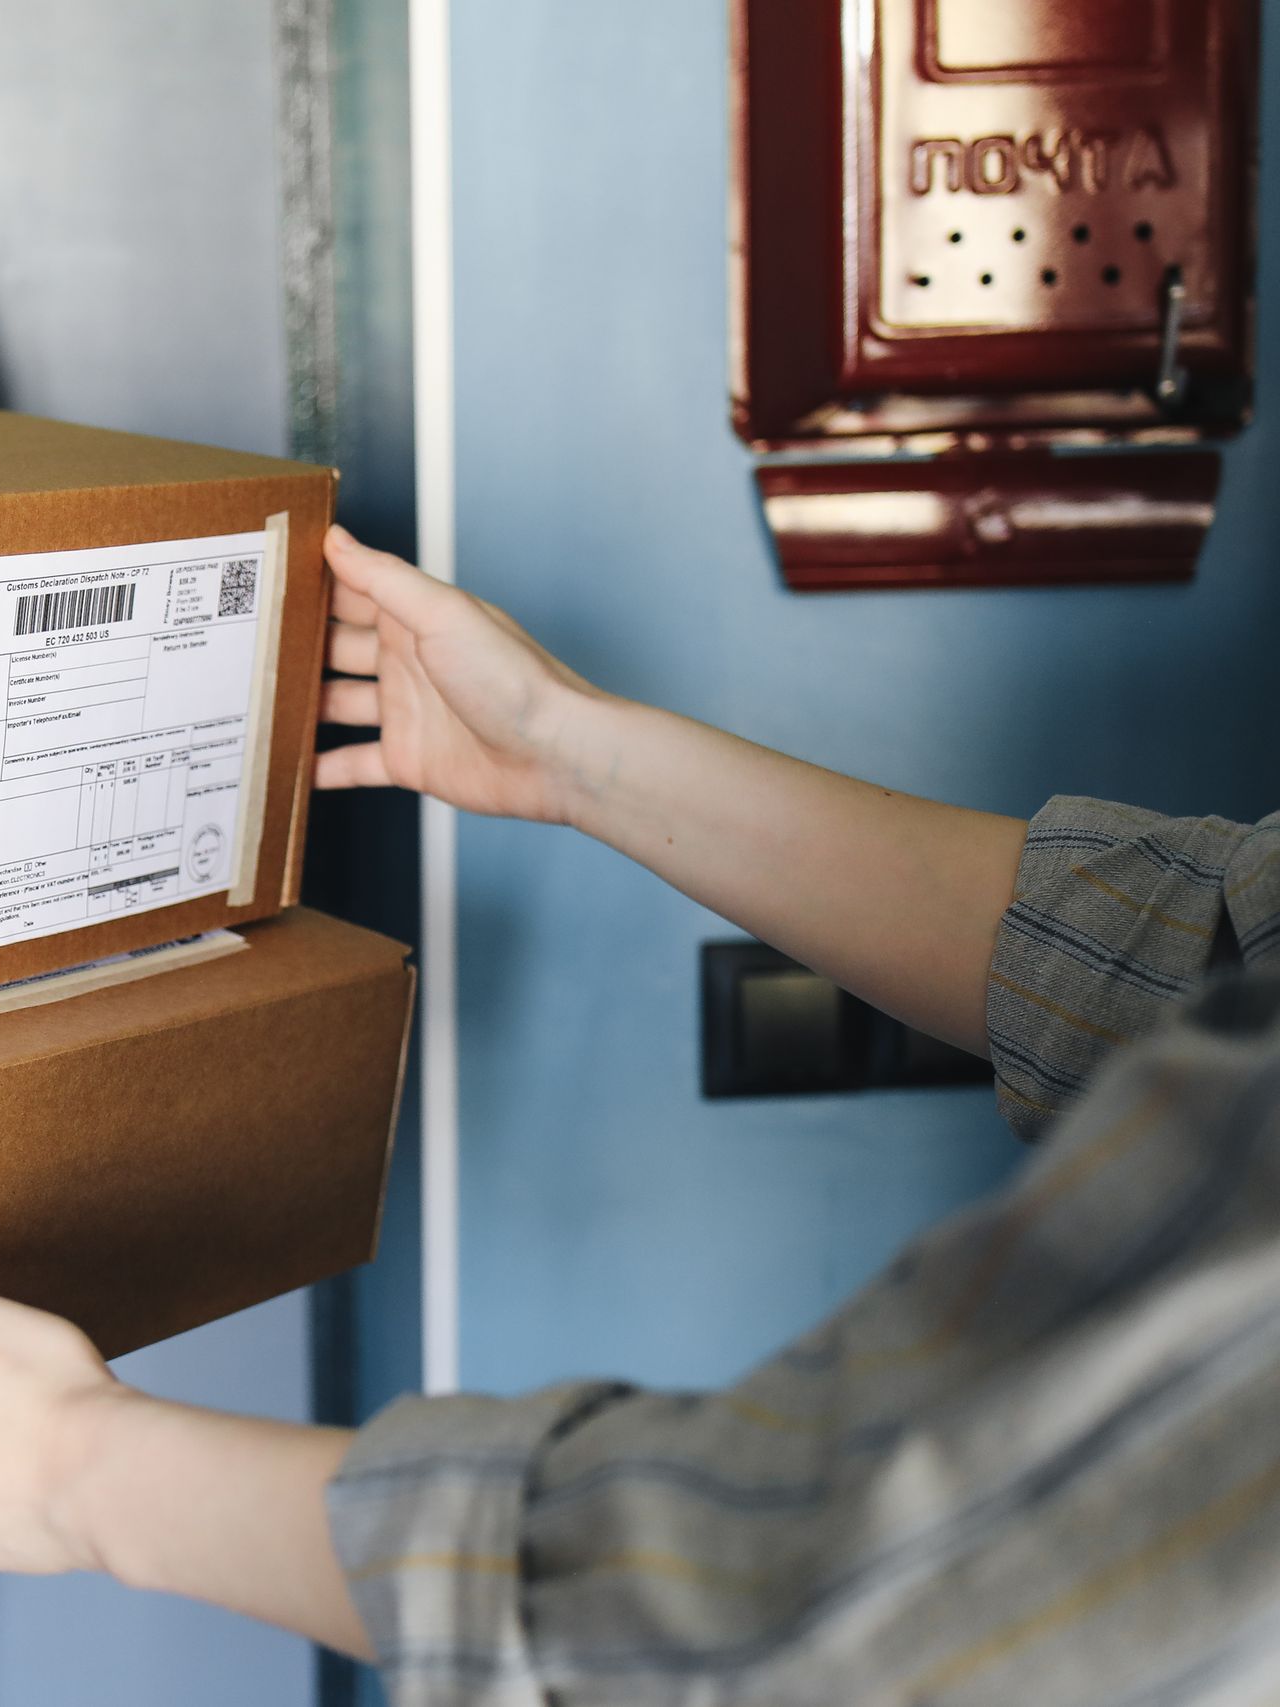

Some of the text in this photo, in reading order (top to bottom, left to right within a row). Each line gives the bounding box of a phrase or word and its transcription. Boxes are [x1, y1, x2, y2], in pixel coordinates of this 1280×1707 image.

[911, 124, 1175, 195] ПОЧТА
[6, 581, 38, 592] Customs
[40, 576, 79, 588] Declaration
[80, 573, 109, 585] Dispatch
[110, 570, 126, 580] Note
[142, 568, 150, 576] 72
[45, 630, 110, 646] EC 720 432 503 US
[11, 651, 58, 664] License Number(s)
[10, 673, 61, 686] Certificate Number(s)
[8, 696, 46, 707] Invoice Number
[7, 720, 32, 729] Importer's
